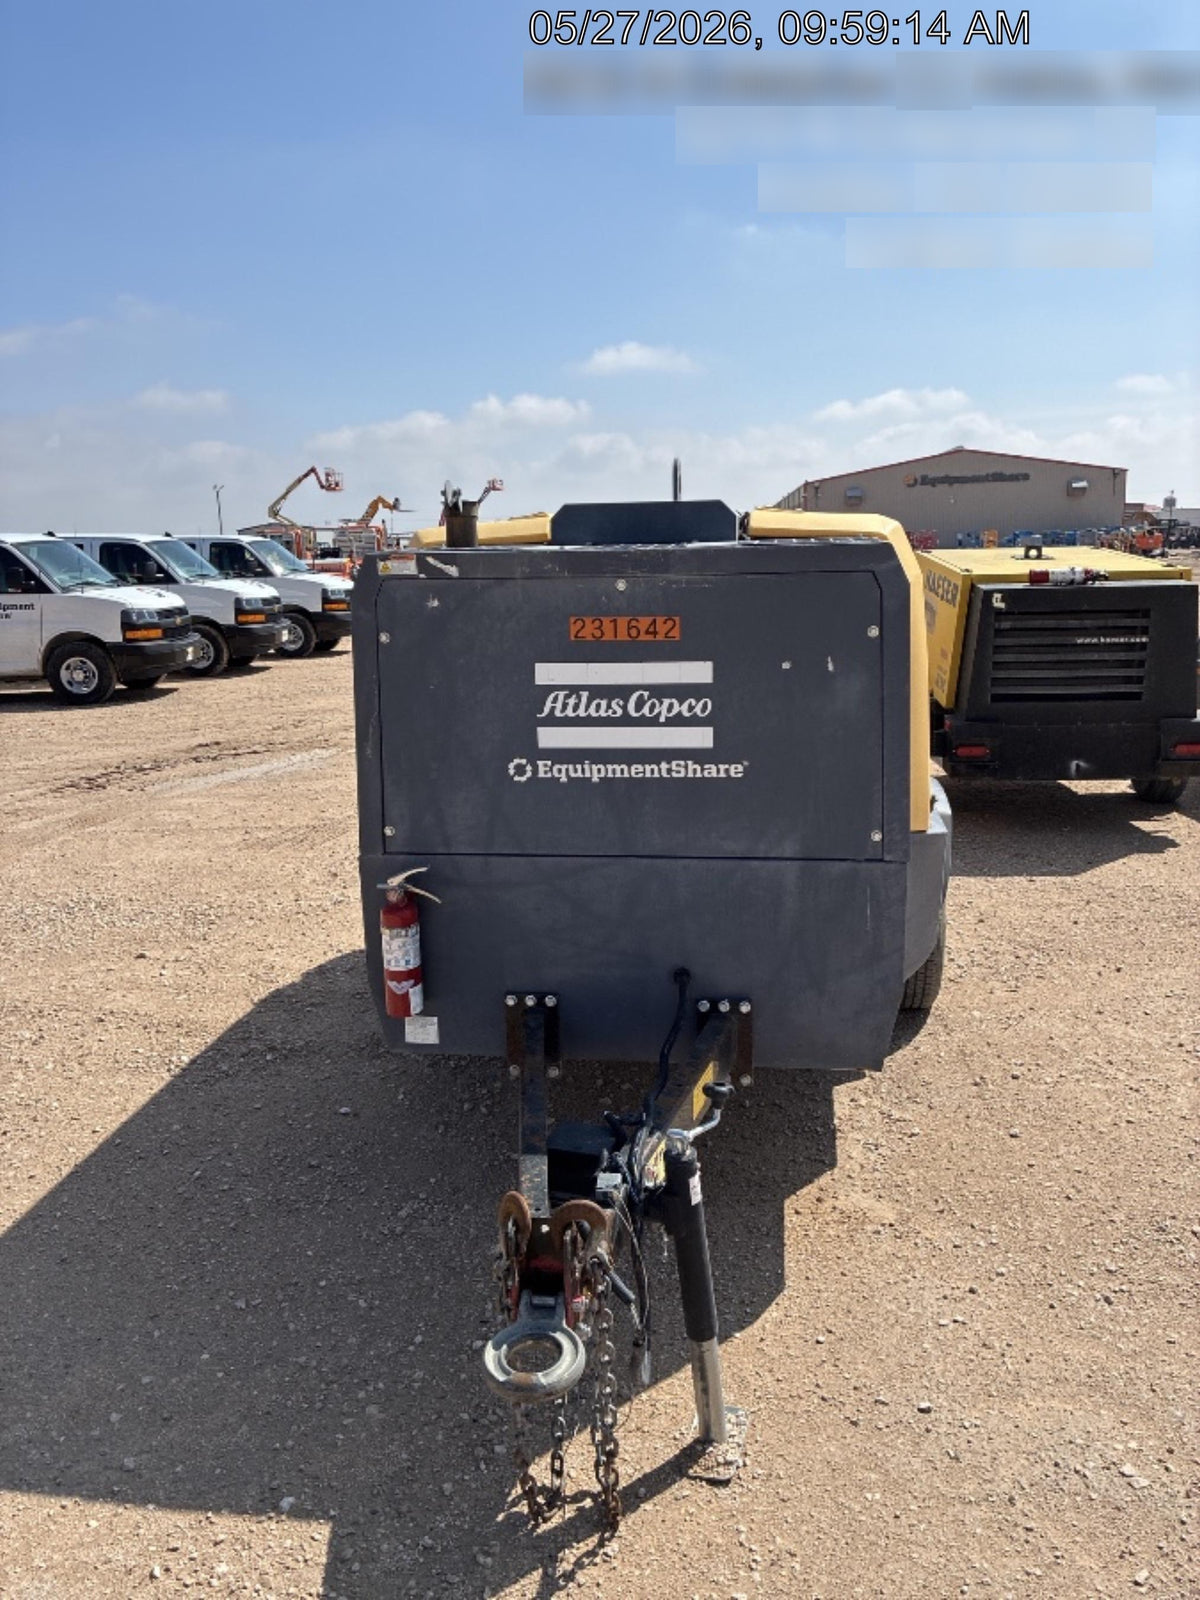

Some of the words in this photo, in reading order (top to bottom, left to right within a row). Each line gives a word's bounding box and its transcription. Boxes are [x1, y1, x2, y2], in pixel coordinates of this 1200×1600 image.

[572, 617, 678, 640] 231642
[536, 690, 625, 718] Atlas
[626, 690, 713, 723] Copco
[536, 760, 745, 783] EquipmentShare
